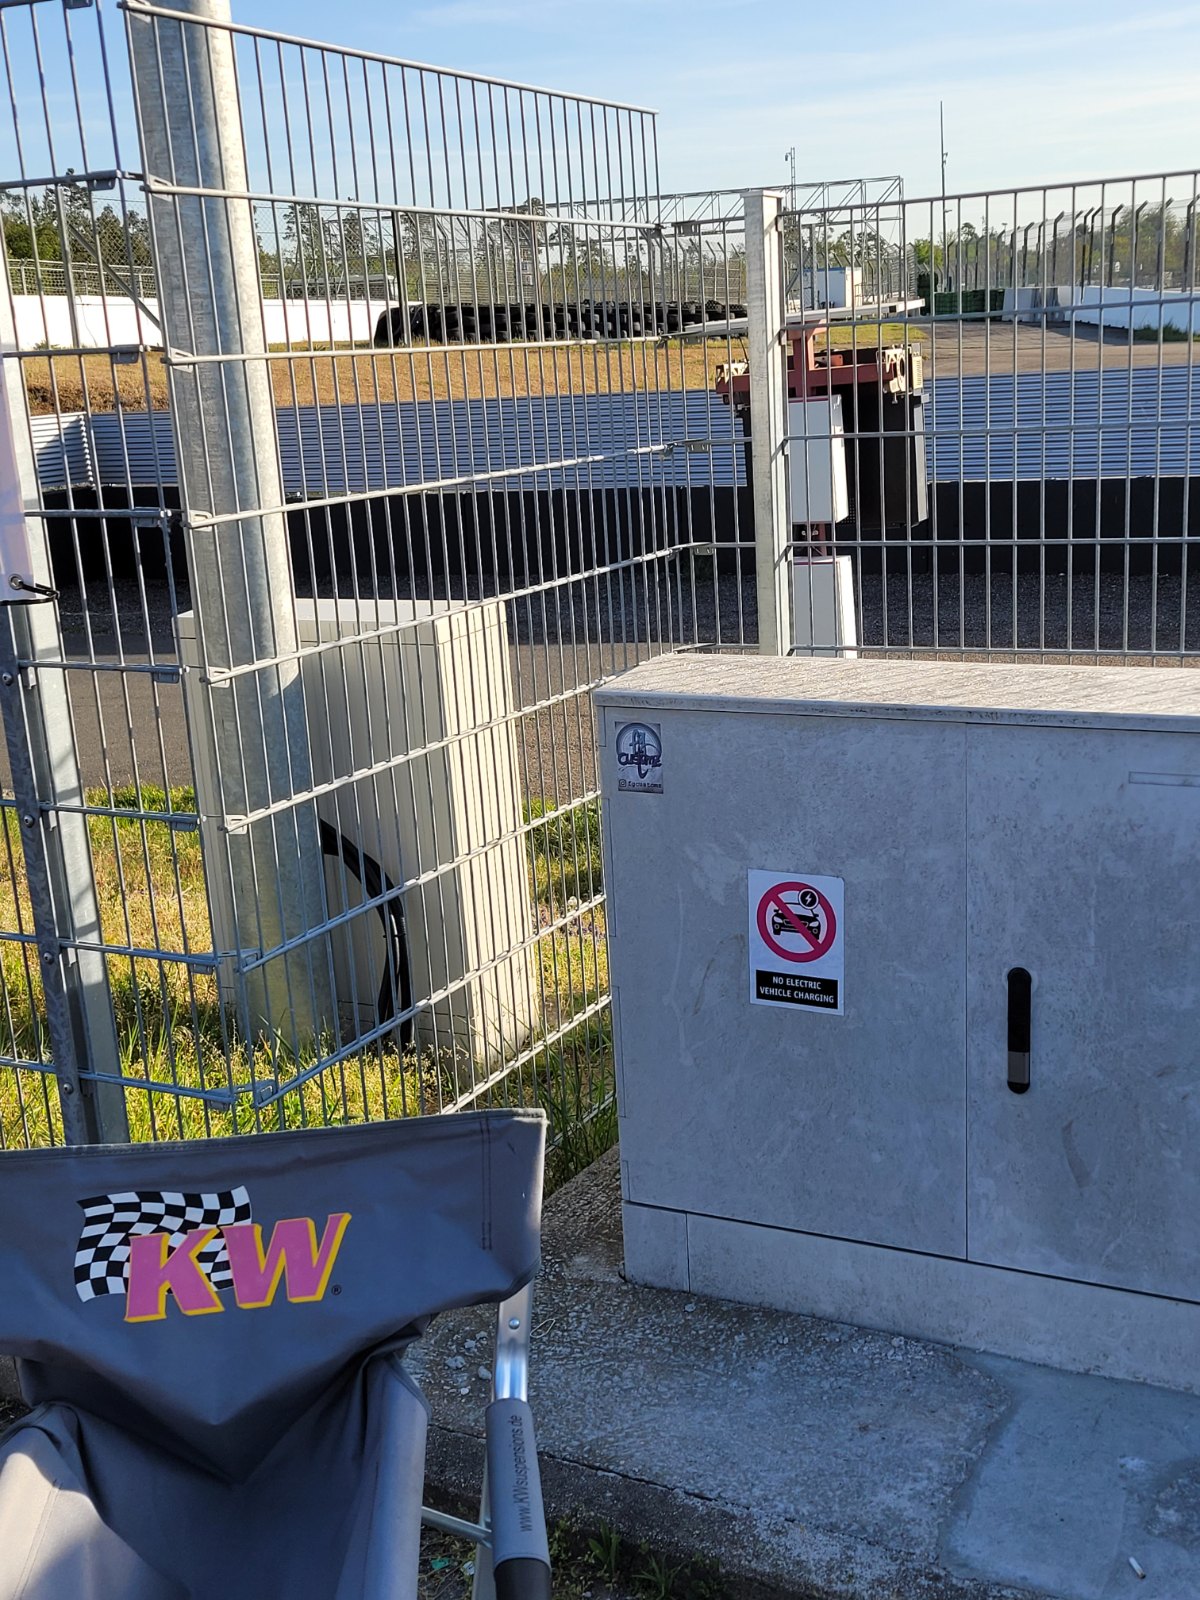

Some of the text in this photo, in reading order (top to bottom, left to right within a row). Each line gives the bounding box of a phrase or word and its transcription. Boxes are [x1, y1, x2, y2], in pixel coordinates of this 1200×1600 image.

[772, 976, 822, 990] NO ELECTRIC
[759, 986, 835, 1004] VEHICLE CHARGING
[508, 1414, 534, 1533] www.KWsuspensions.de
